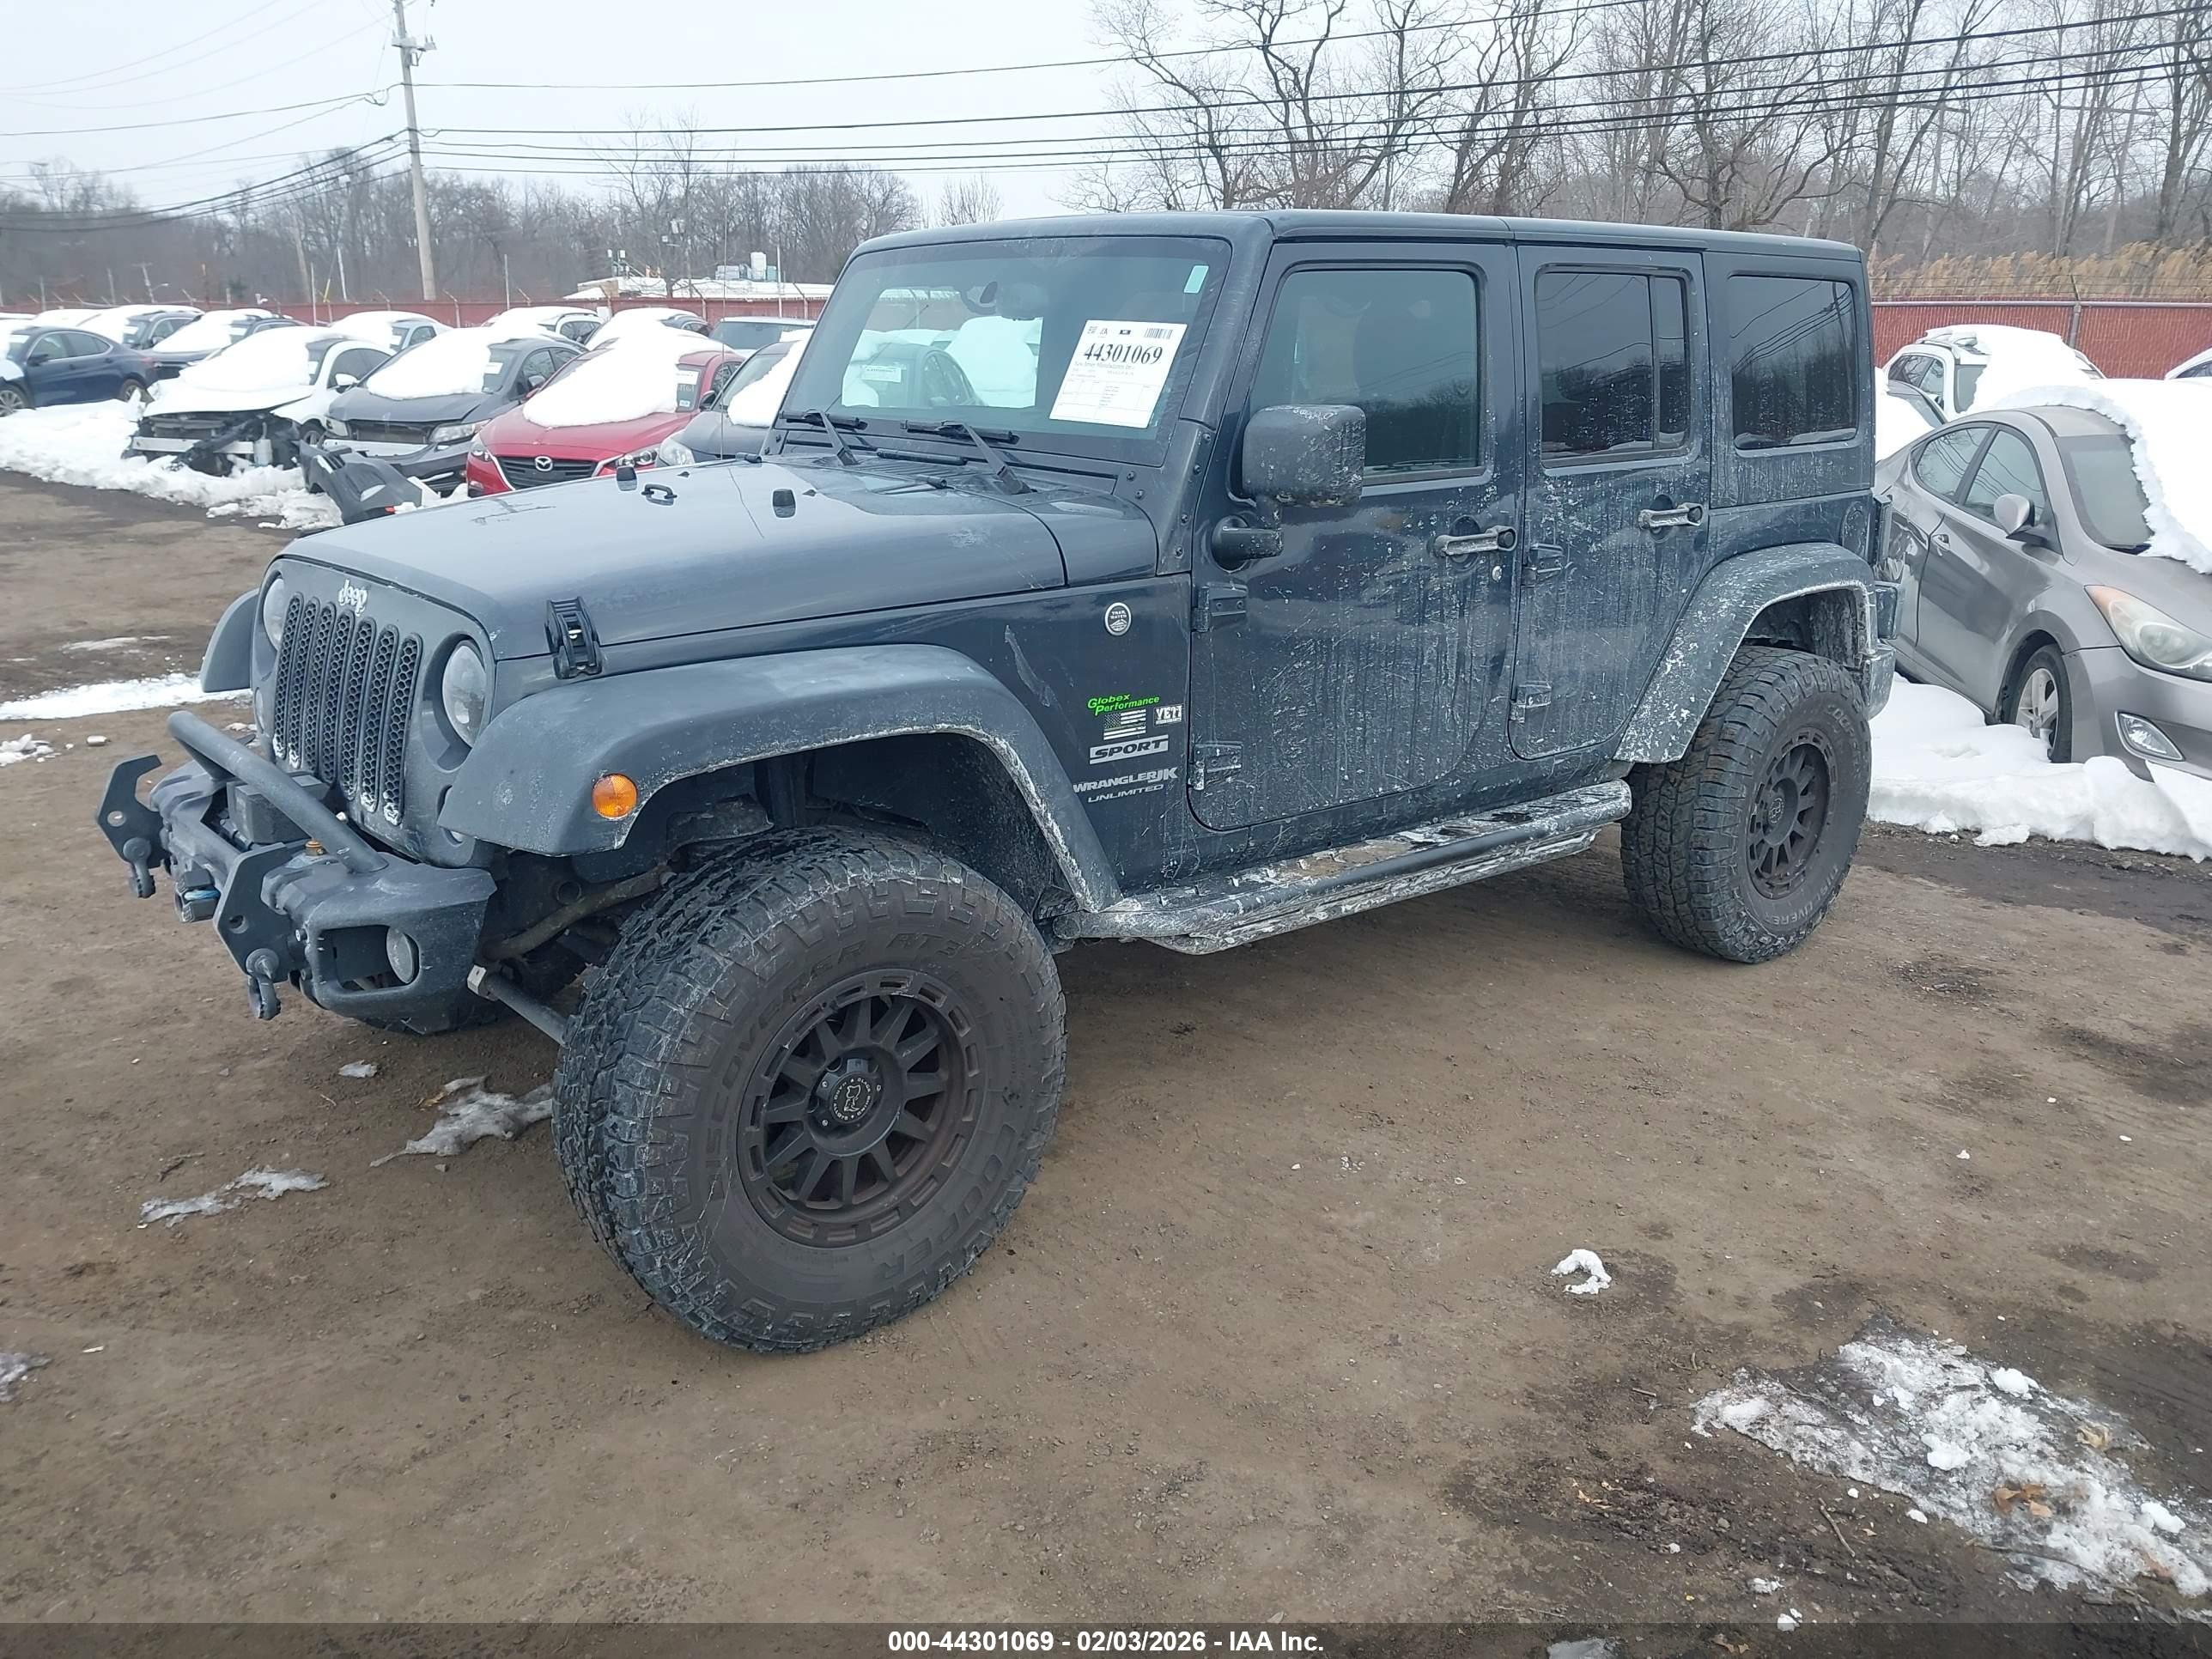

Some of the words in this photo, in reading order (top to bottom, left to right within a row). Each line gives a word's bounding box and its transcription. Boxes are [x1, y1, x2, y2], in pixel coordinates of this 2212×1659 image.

[1083, 343, 1163, 365] 44301069
[1087, 694, 1131, 709] Globex
[1095, 696, 1160, 716] Performance
[1156, 705, 1182, 720] YETI
[1094, 740, 1164, 759] SPORT
[1088, 784, 1164, 803] UNLIMITED
